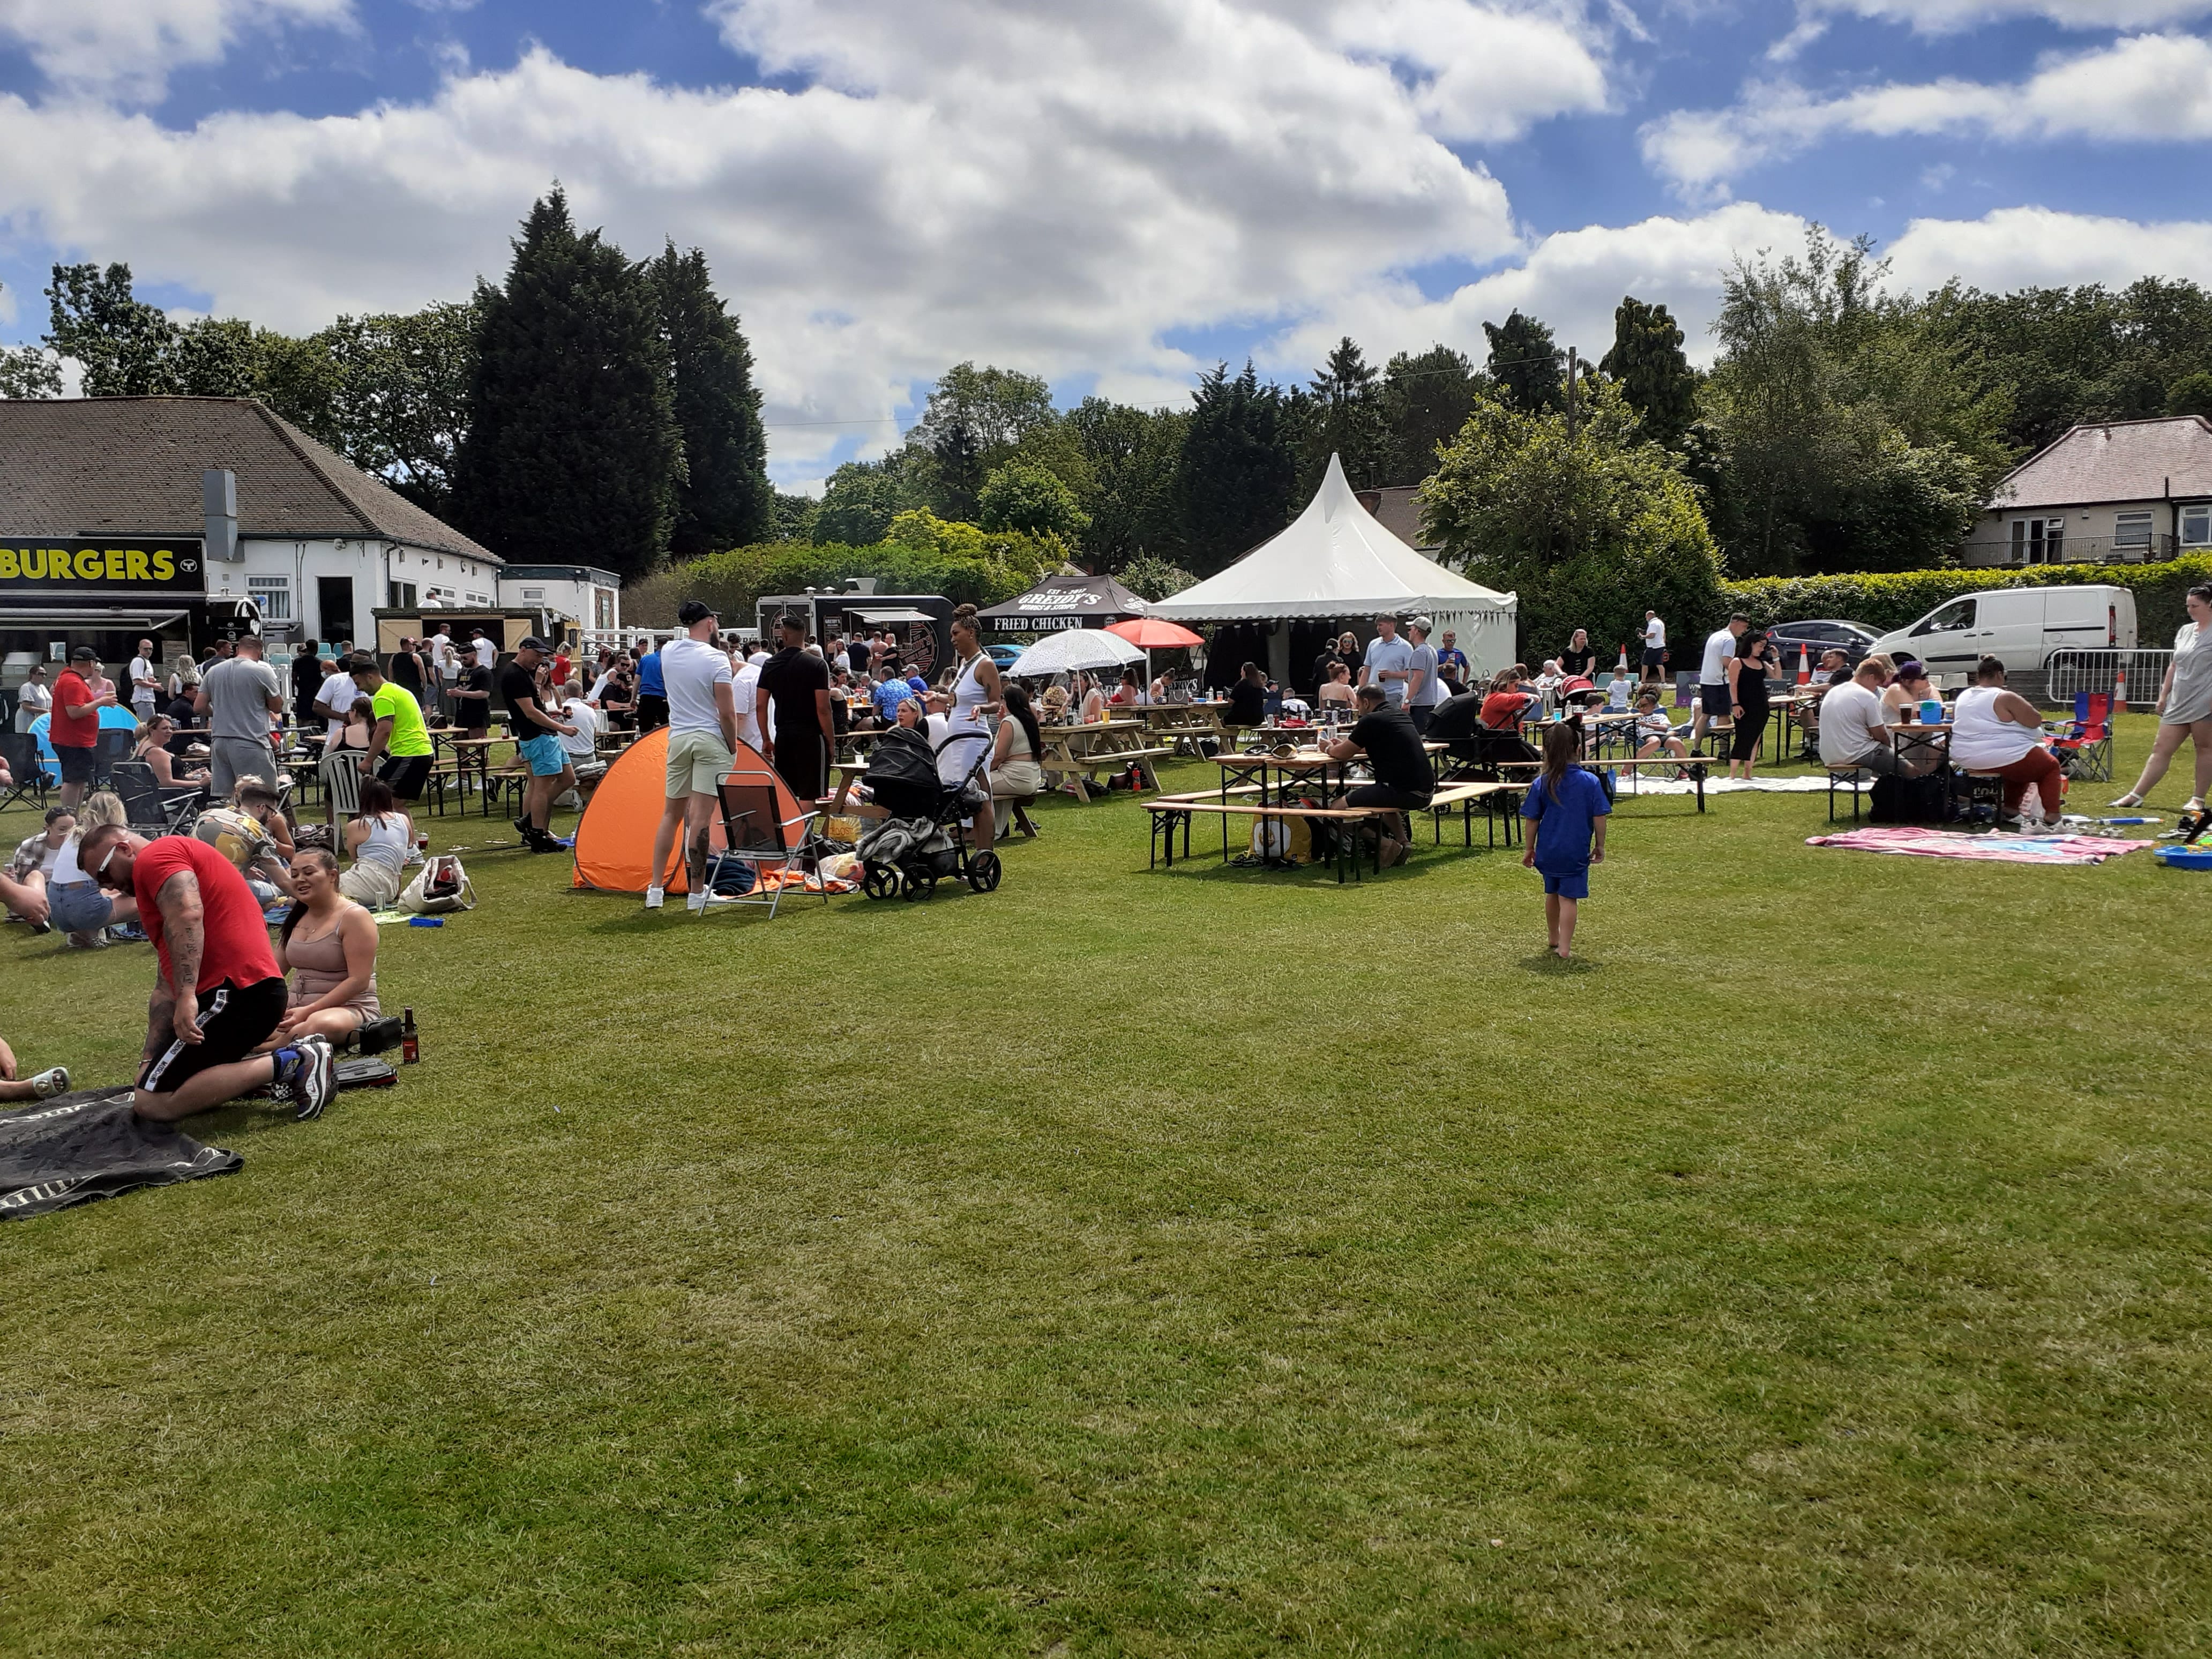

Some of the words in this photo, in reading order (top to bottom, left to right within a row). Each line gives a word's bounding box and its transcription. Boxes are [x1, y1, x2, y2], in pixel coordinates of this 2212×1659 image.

[0, 549, 175, 580] BURGERS
[1018, 593, 1102, 605] GREIDY'S
[994, 618, 1028, 630] FRIED
[1032, 617, 1083, 630] CHICKEN
